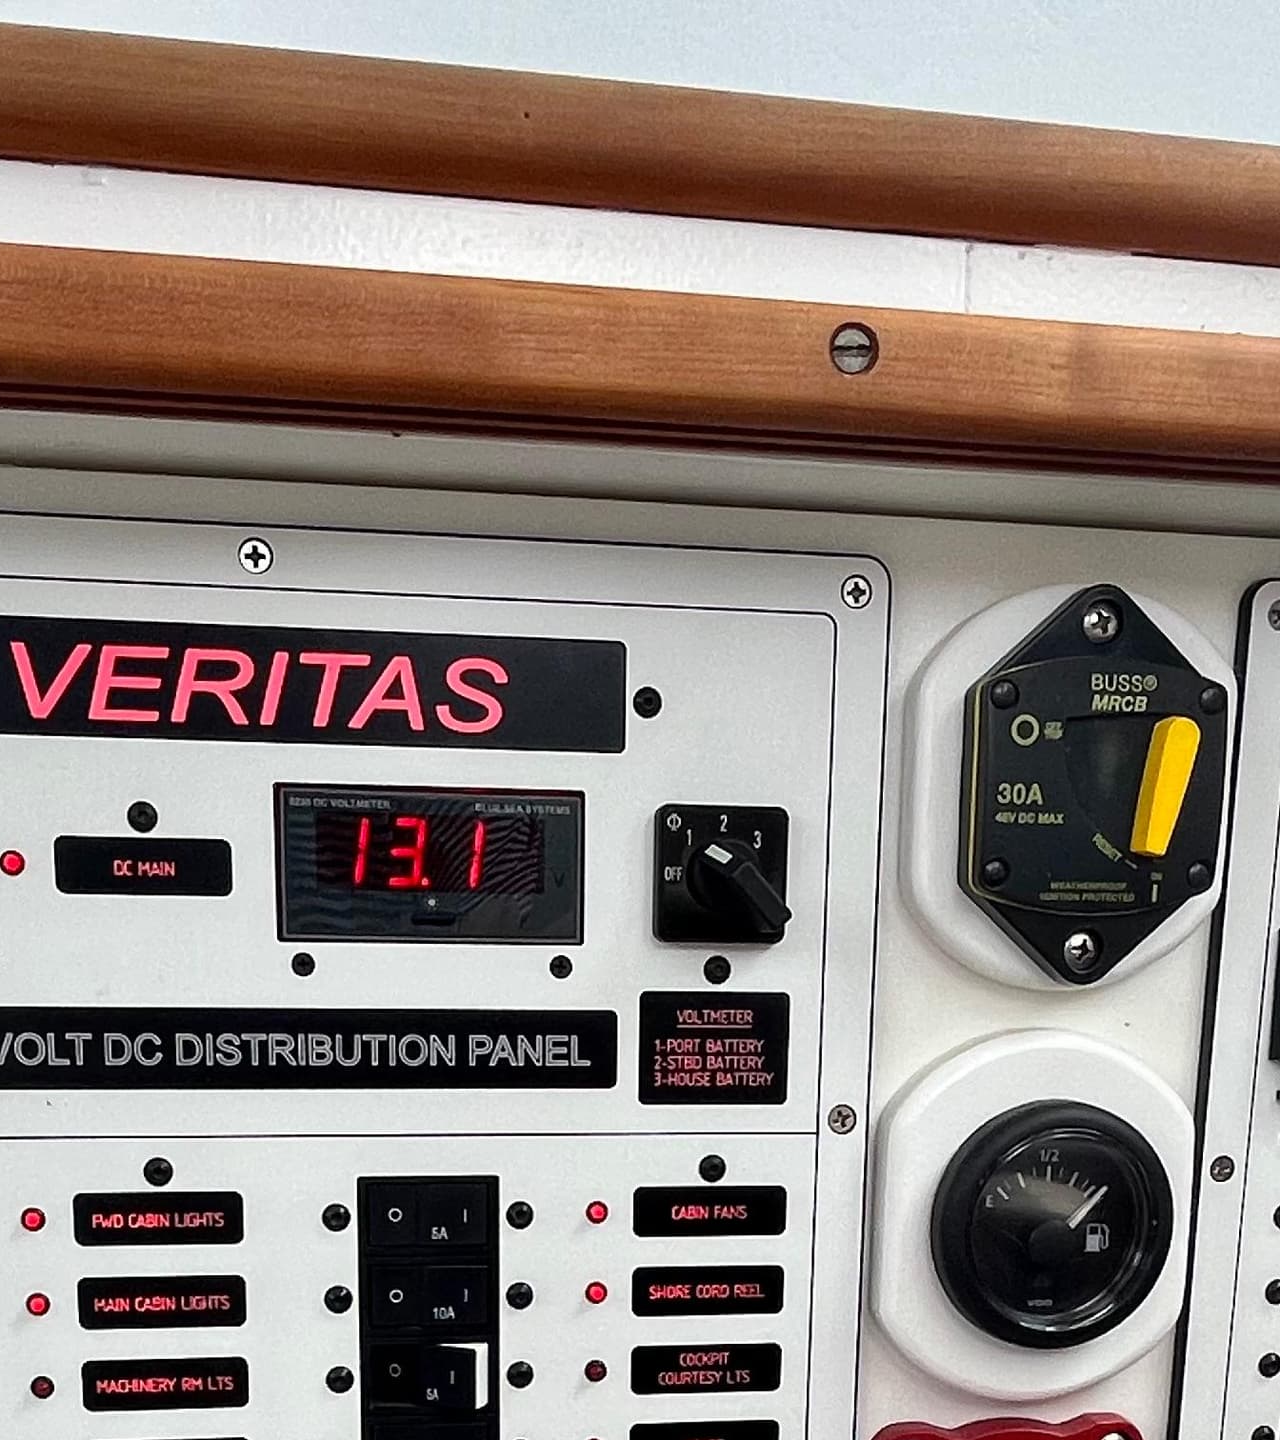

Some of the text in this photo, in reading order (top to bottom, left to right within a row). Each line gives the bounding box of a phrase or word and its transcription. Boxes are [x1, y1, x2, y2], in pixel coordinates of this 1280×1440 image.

[10, 642, 508, 733] VERITAS
[1092, 694, 1147, 711] MRCB
[997, 783, 1042, 805] 30A
[114, 860, 175, 876] DC MAIN
[664, 867, 682, 880] OFF
[677, 1010, 753, 1024] VOLTMETER
[104, 1033, 163, 1066] DC
[176, 1033, 455, 1066] DISTRIBUTION
[469, 1035, 591, 1066] PANEL
[655, 1039, 764, 1053] 1-PORT BATTERY
[655, 1056, 764, 1070] 2-STBD BATTERY
[655, 1072, 774, 1086] 3-HOUSE BATTERY
[1040, 1149, 1059, 1162] 1/2
[92, 1212, 224, 1228] FWD CABIN LIGHTS
[672, 1206, 747, 1220] CABIN FANS
[432, 1227, 448, 1239] 5A
[649, 1284, 764, 1299] SHORE CORD REEL
[95, 1295, 230, 1312] MAIN CABIN LIGHTS
[433, 1306, 455, 1319] 10A
[680, 1352, 729, 1366] COCKPIT
[97, 1376, 233, 1393] MACHINERY RM LTS
[658, 1370, 750, 1385] COURTESY LTS
